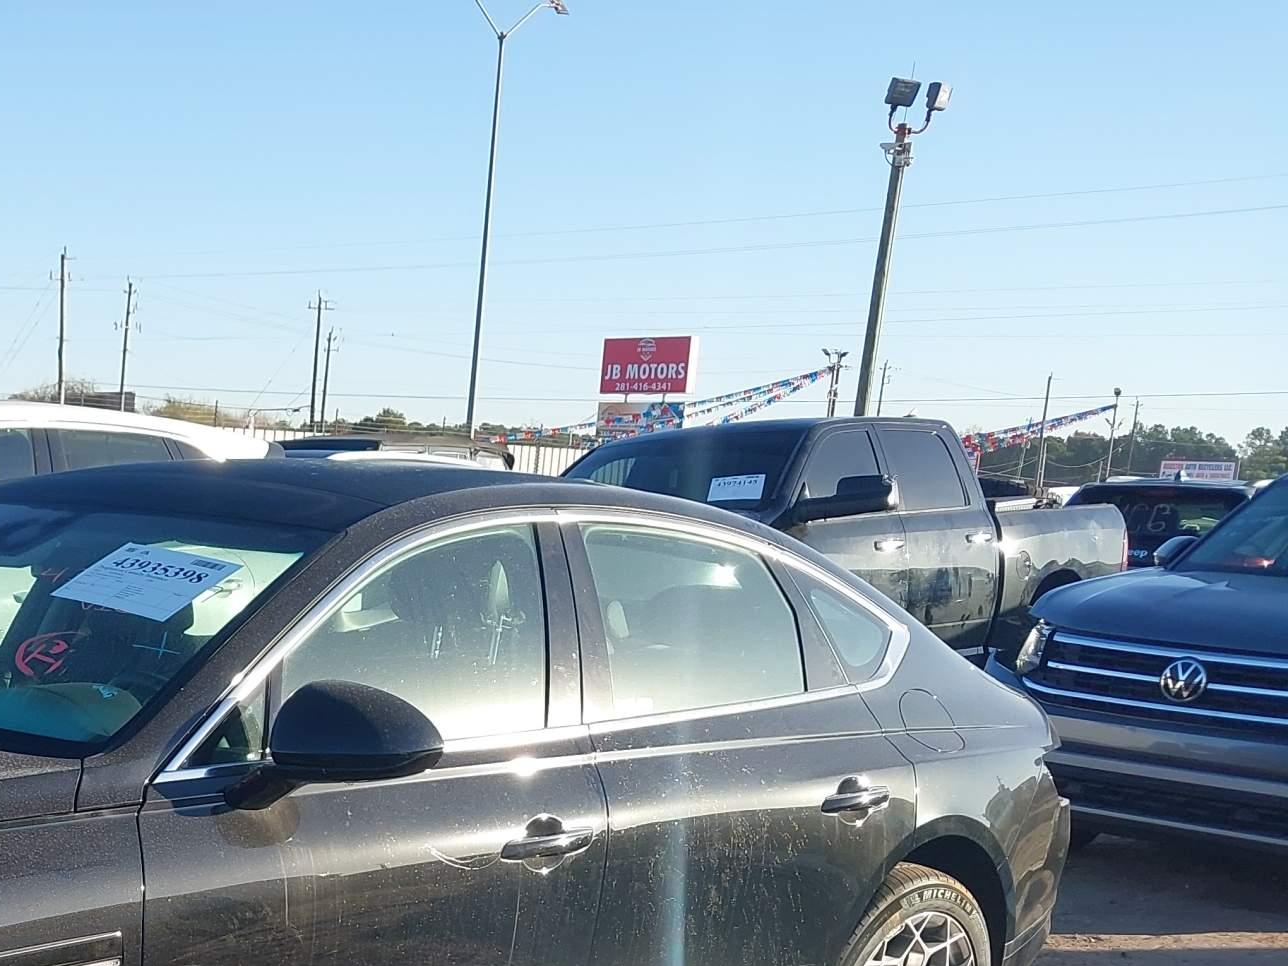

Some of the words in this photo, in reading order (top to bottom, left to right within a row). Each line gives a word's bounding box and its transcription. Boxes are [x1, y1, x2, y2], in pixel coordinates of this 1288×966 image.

[605, 364, 621, 380] JB
[625, 362, 686, 379] MOTORS
[615, 382, 672, 391] 281-416-4341
[113, 557, 209, 584] 43935398
[922, 888, 973, 914] MICHELIN
